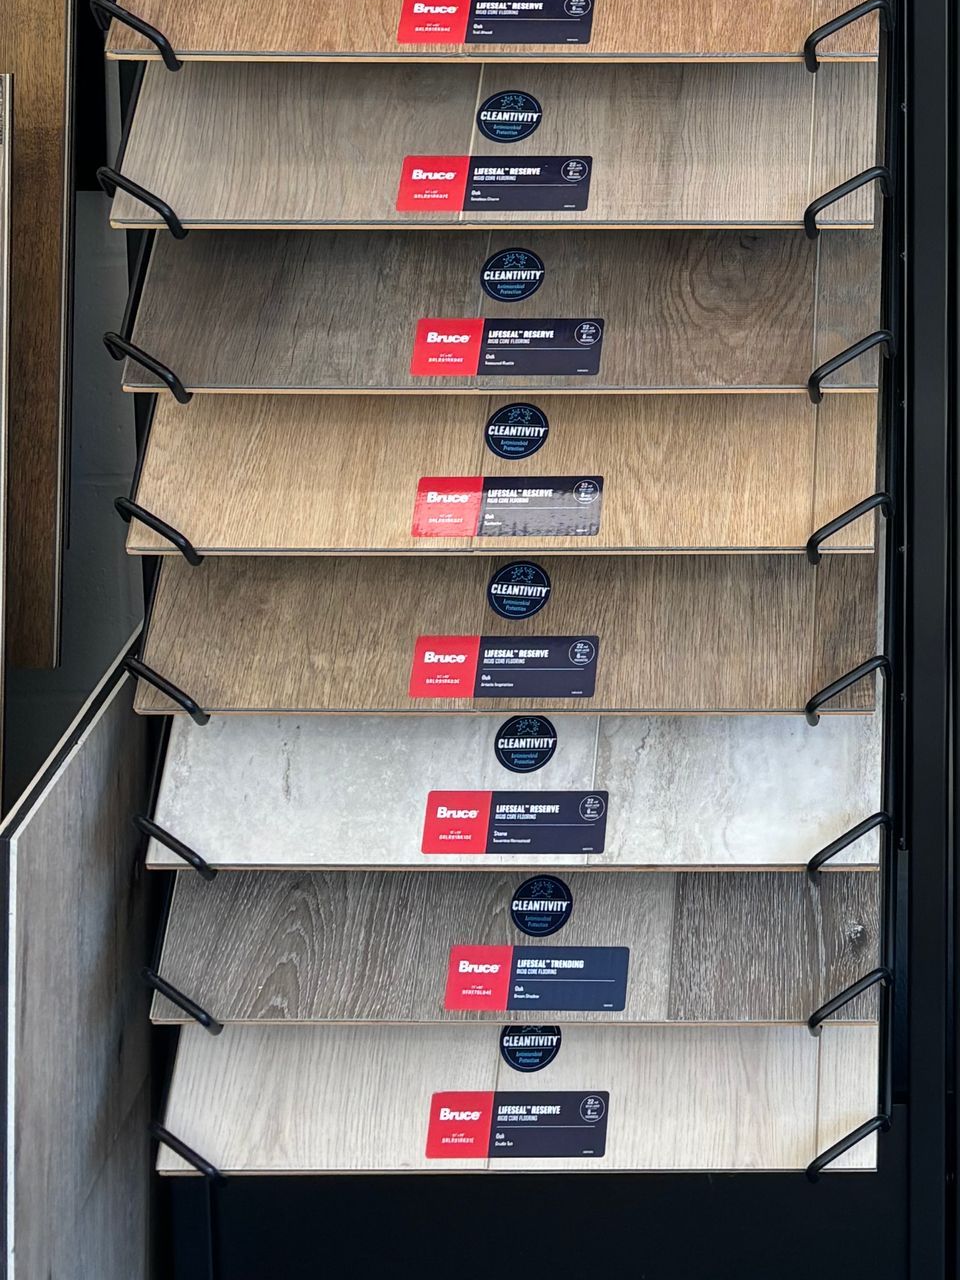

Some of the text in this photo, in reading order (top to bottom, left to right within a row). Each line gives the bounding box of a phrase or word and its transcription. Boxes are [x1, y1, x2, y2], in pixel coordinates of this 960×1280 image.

[414, 3, 458, 14] Bruce
[412, 170, 456, 180] Bruce
[427, 332, 471, 343] Bruce
[427, 492, 471, 503] Bruce
[424, 651, 467, 663] Bruce
[437, 807, 479, 819] Bruce
[459, 961, 500, 973] Bruce
[551, 960, 584, 968] TRENDING
[439, 1108, 481, 1121] Bruce
